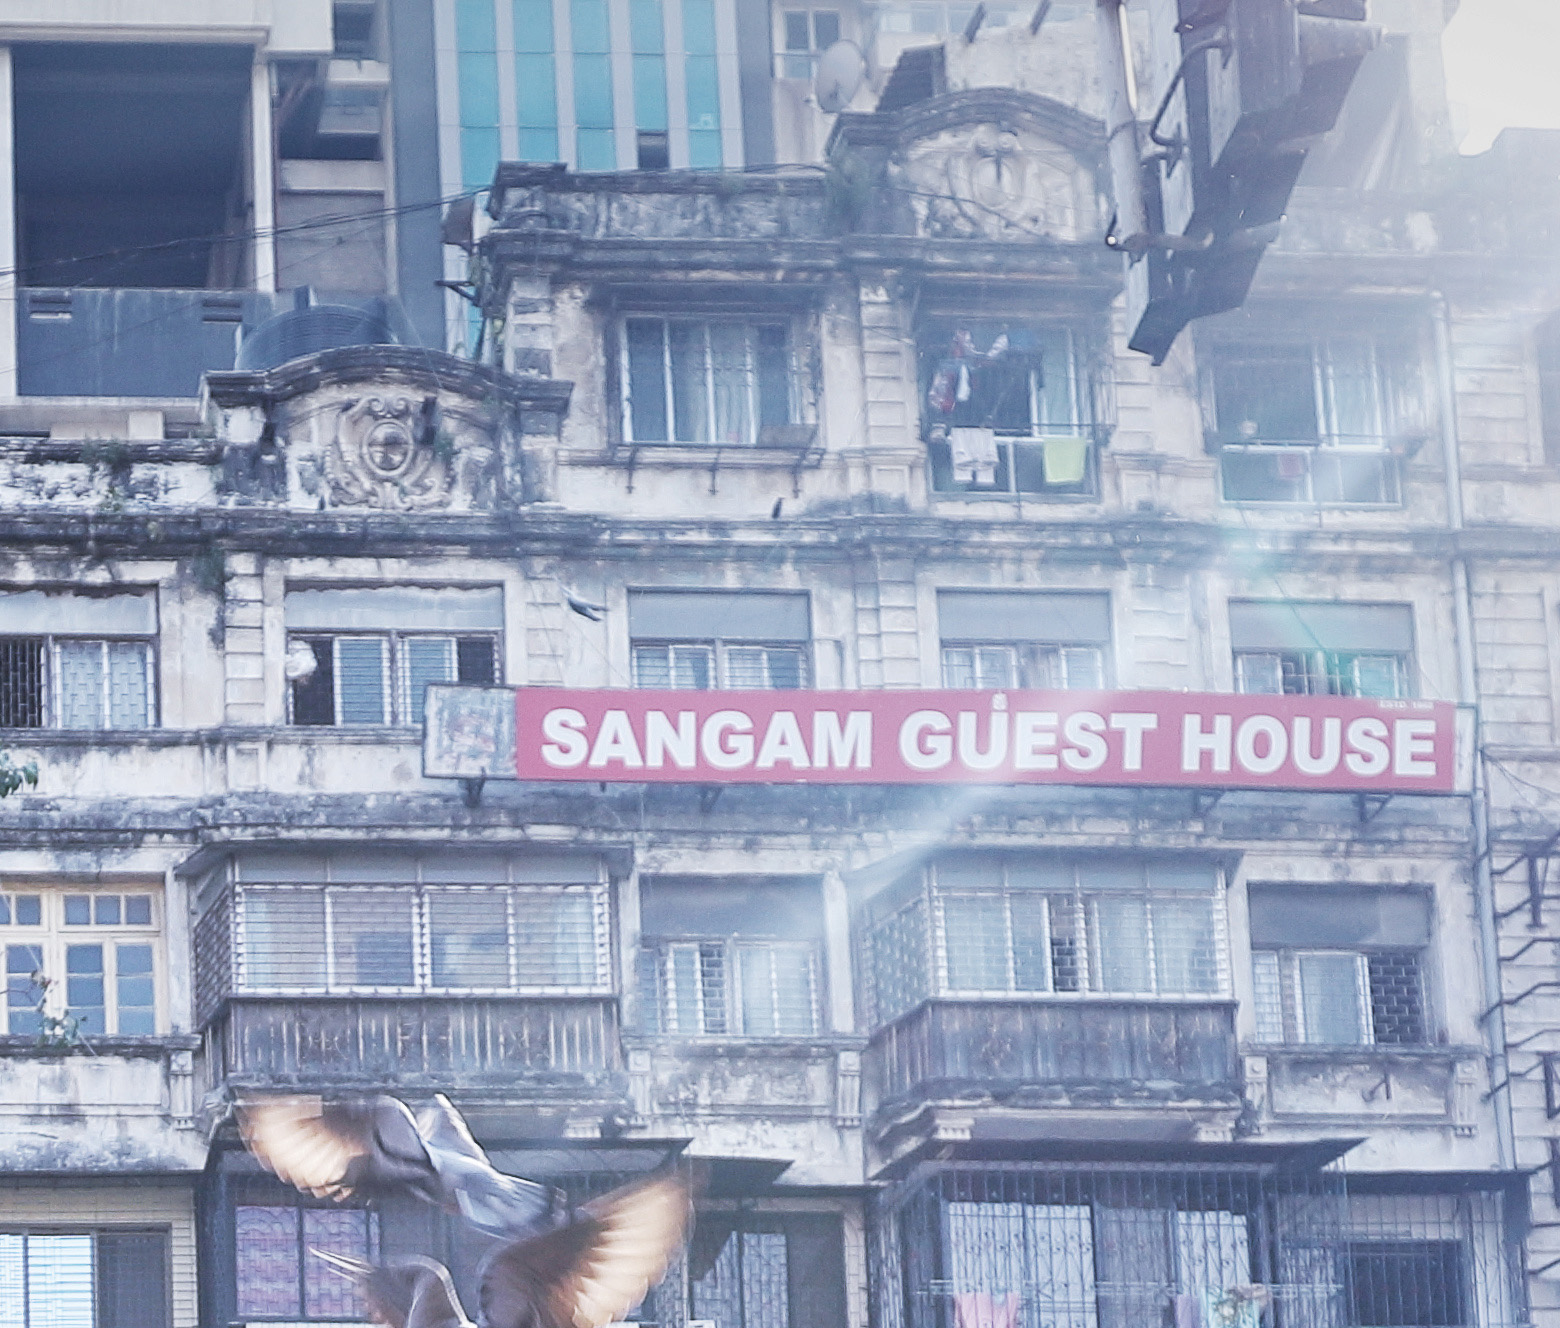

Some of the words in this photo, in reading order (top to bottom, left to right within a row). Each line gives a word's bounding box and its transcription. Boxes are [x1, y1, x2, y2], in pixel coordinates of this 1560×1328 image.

[540, 706, 872, 770] SANGAM
[899, 708, 1157, 772] GUEST
[1182, 711, 1437, 777] HOUSE
